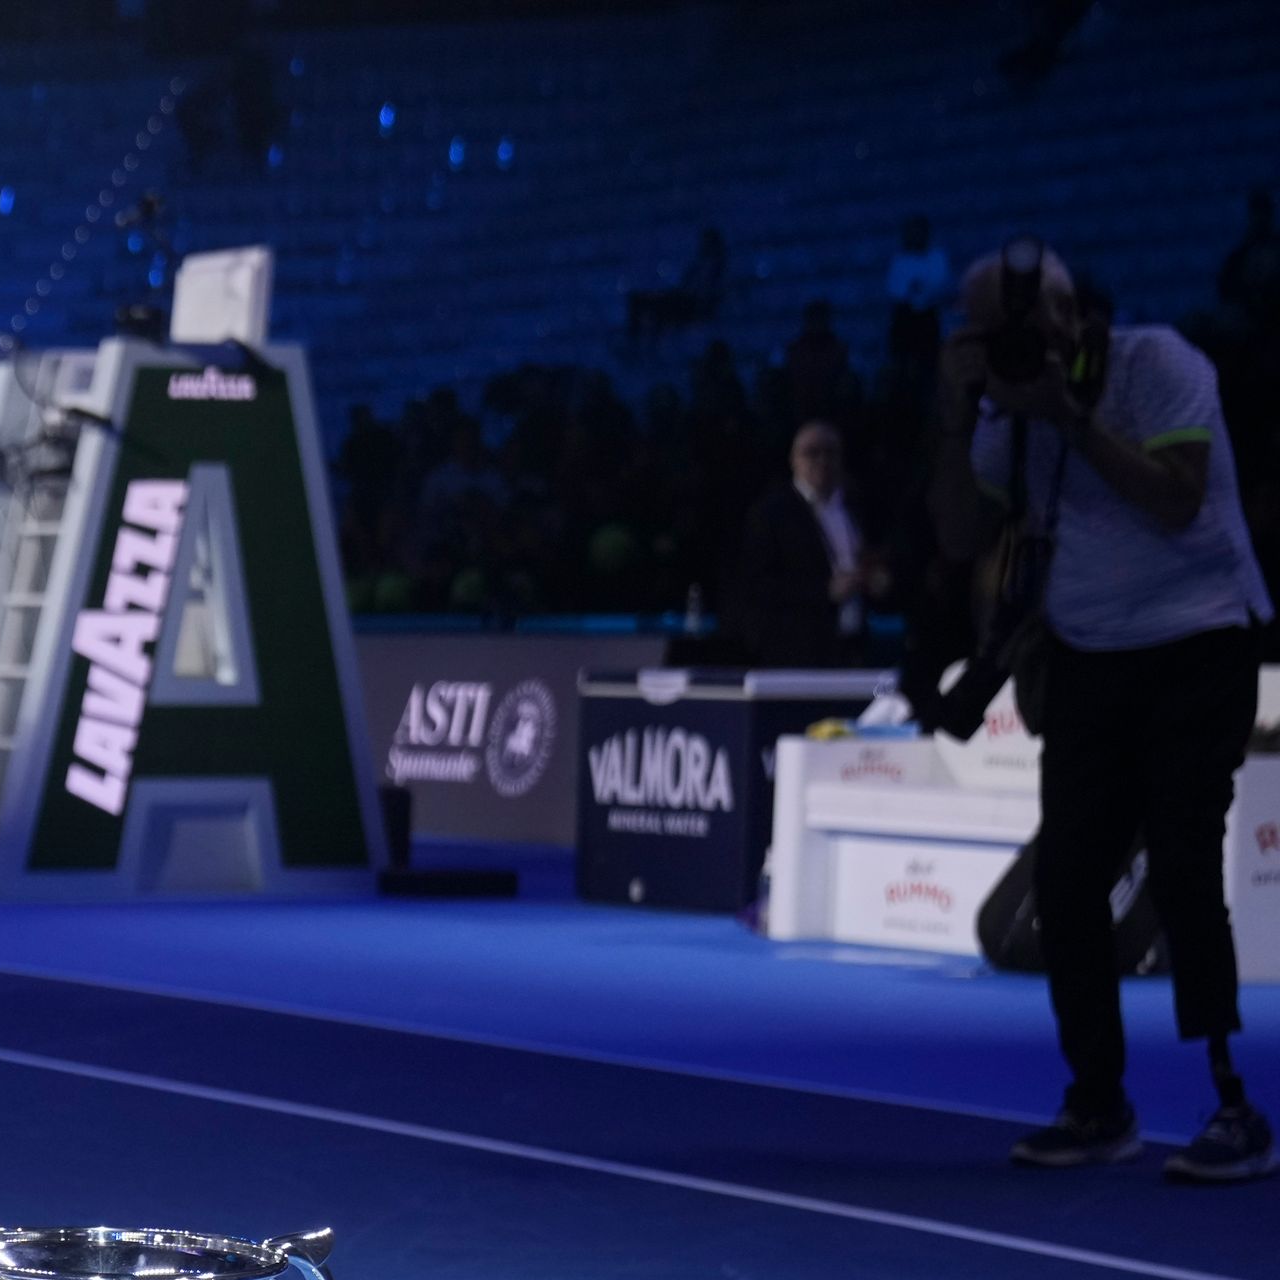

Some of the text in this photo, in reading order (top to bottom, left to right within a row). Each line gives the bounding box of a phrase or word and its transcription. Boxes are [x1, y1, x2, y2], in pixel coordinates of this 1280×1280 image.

[64, 479, 189, 816] LAVAZZA
[394, 680, 492, 746] ASTI
[589, 725, 734, 814] VALMORA
